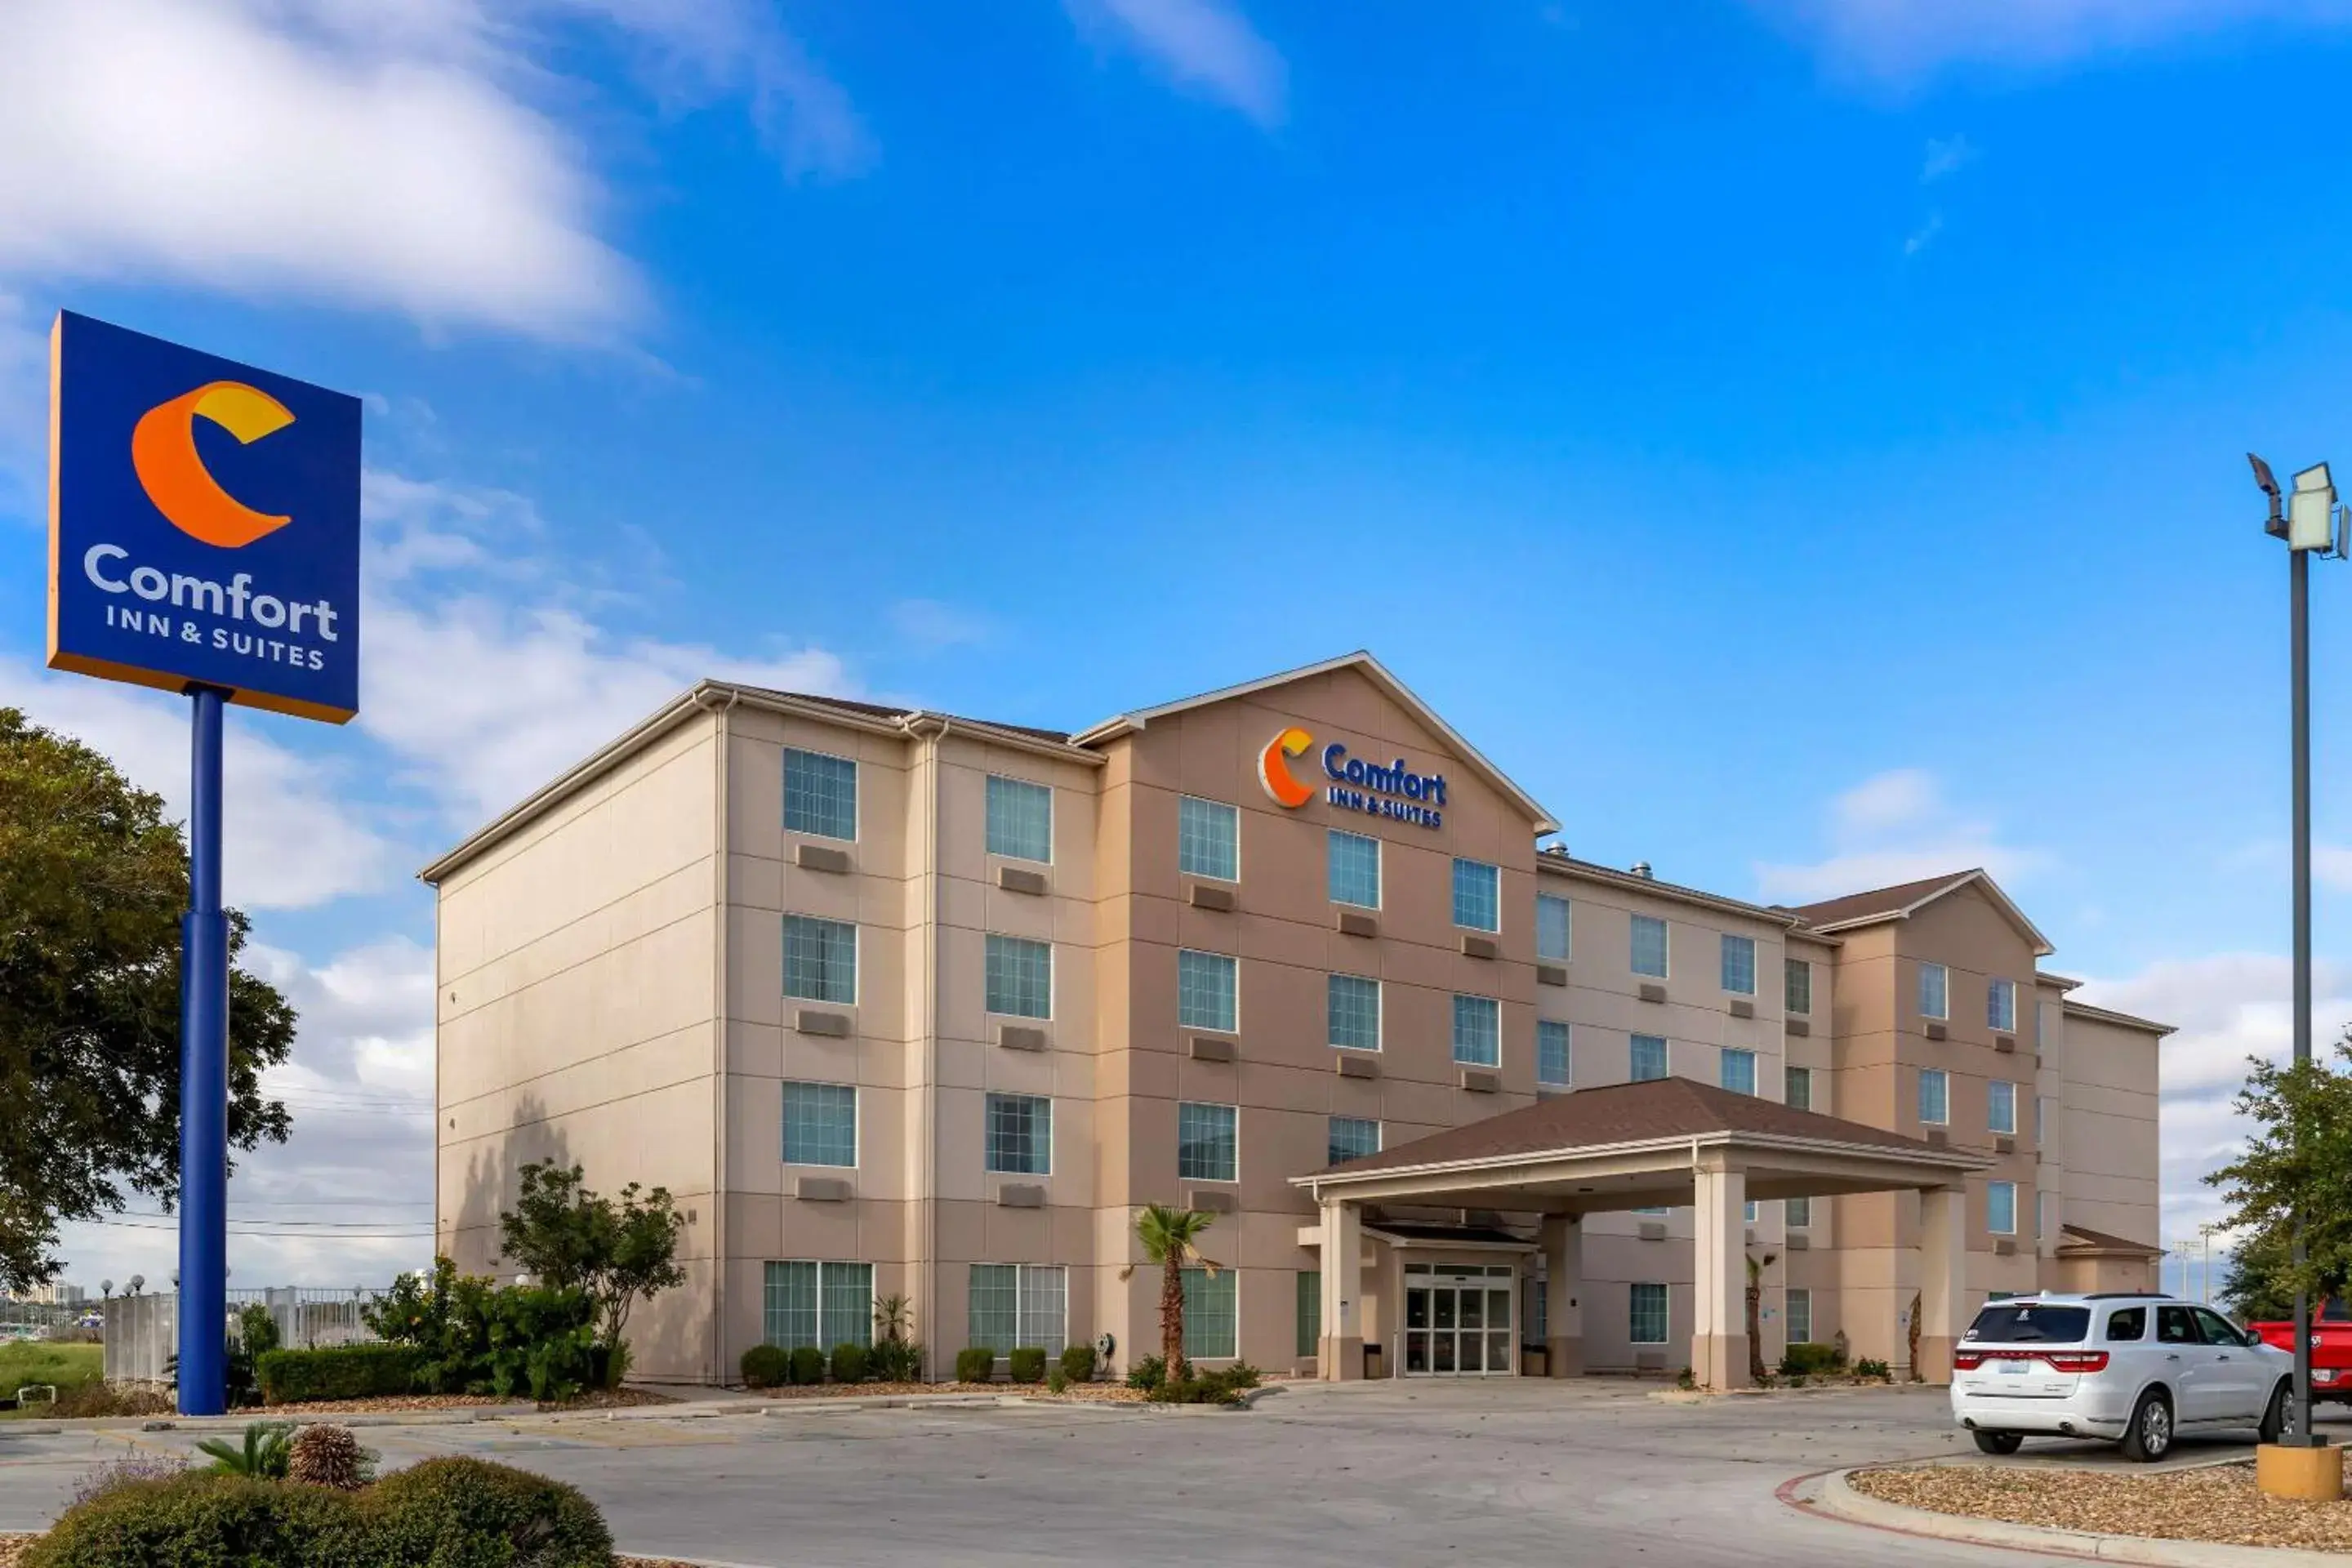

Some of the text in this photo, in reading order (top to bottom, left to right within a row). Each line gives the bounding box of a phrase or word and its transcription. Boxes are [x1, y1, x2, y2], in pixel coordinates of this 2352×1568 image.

[84, 543, 337, 642] Comfort
[106, 605, 324, 670] INN & SUITES
[1321, 743, 1446, 806] Comfort
[1327, 786, 1441, 829] INN & SUITES
